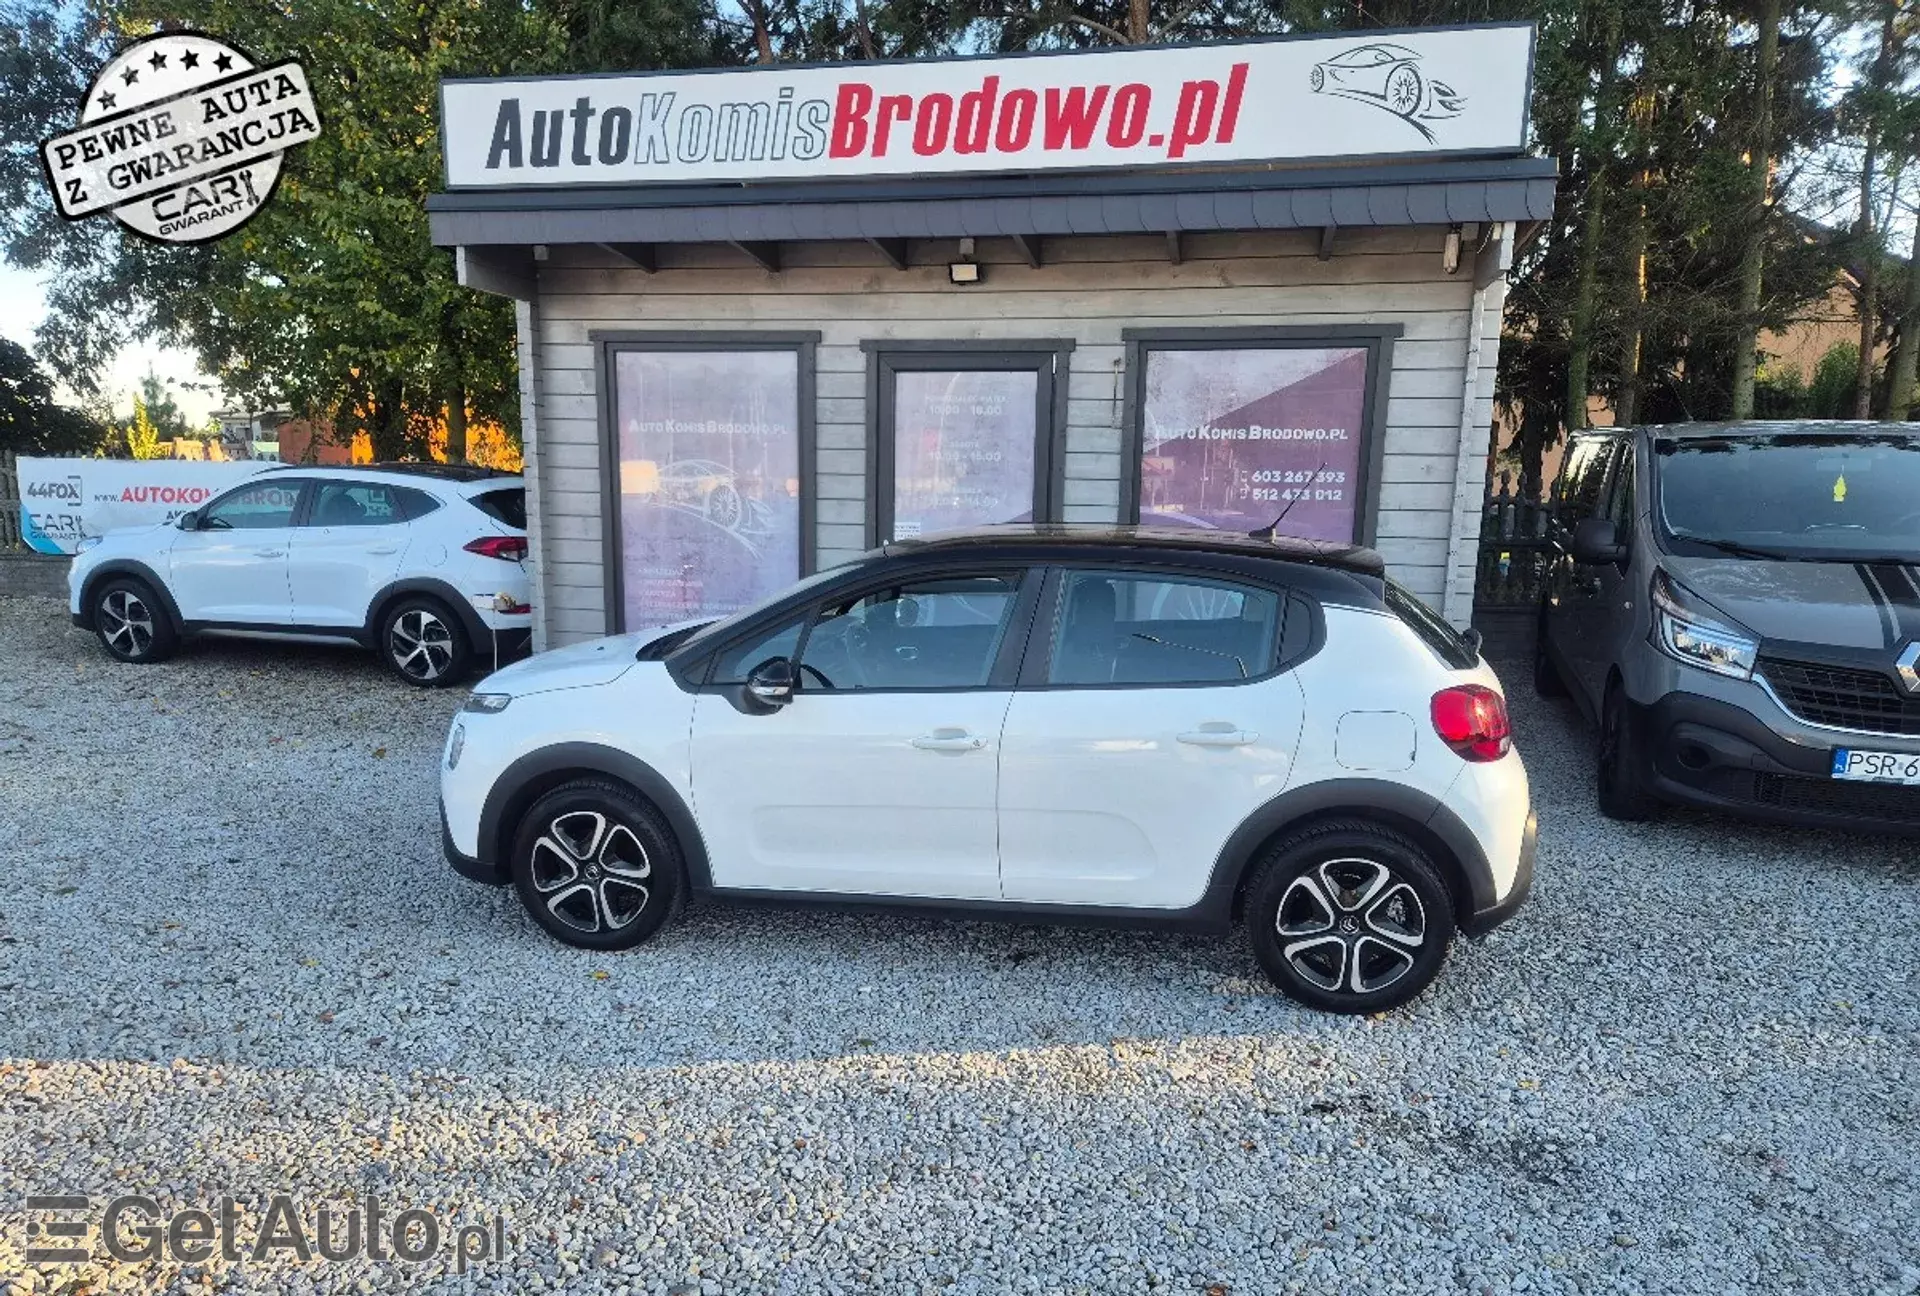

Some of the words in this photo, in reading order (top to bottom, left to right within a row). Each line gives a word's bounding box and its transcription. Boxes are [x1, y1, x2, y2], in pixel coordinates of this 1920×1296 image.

[486, 62, 1249, 168] AutoKomisBrodowo.pl
[1251, 470, 1281, 483] 603
[1284, 470, 1313, 483] 267
[1316, 471, 1346, 483] 393
[27, 480, 80, 501] 44FOX
[1252, 487, 1279, 500] 512
[1282, 488, 1311, 500] 473
[1315, 489, 1342, 501] 012
[30, 514, 76, 531] CAR
[1847, 753, 1897, 776] PSR
